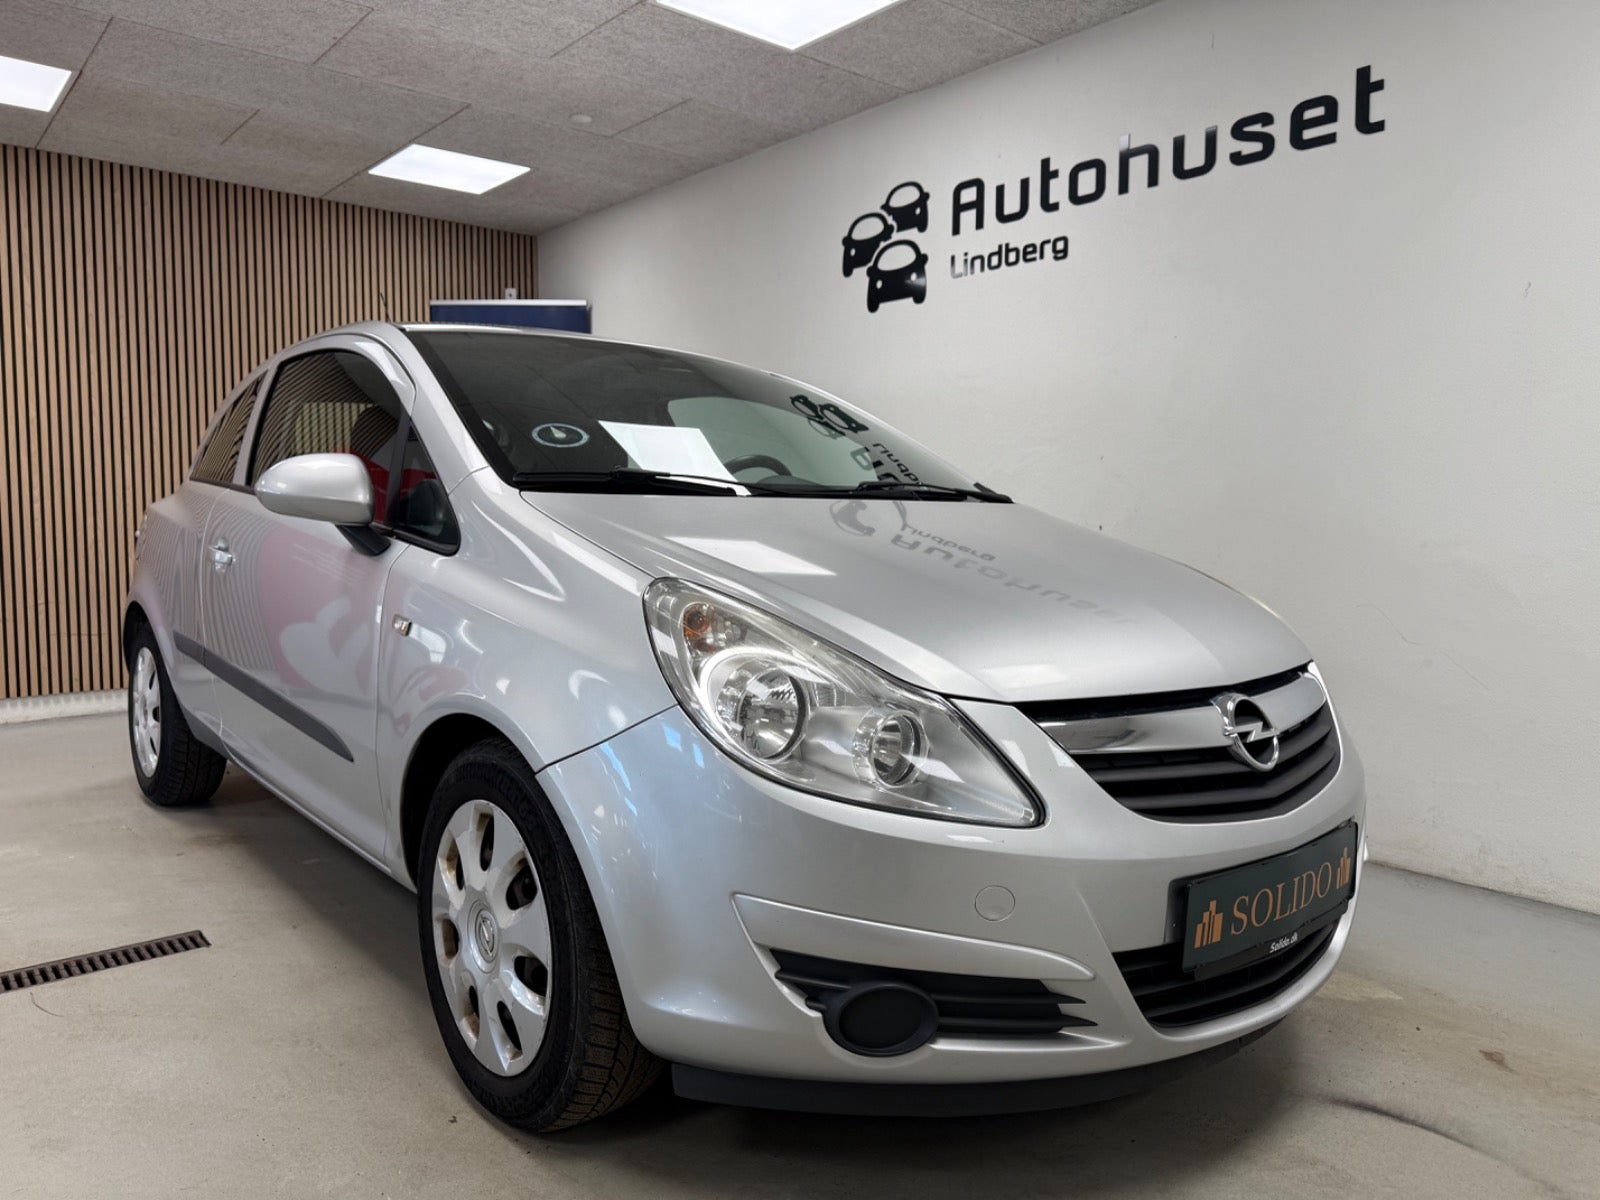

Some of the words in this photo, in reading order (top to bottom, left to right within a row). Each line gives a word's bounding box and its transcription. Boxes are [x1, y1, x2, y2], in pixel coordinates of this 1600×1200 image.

[951, 64, 1386, 236] Autohuset
[950, 235, 1069, 279] Lindberg
[1230, 861, 1333, 936] SOLIDO
